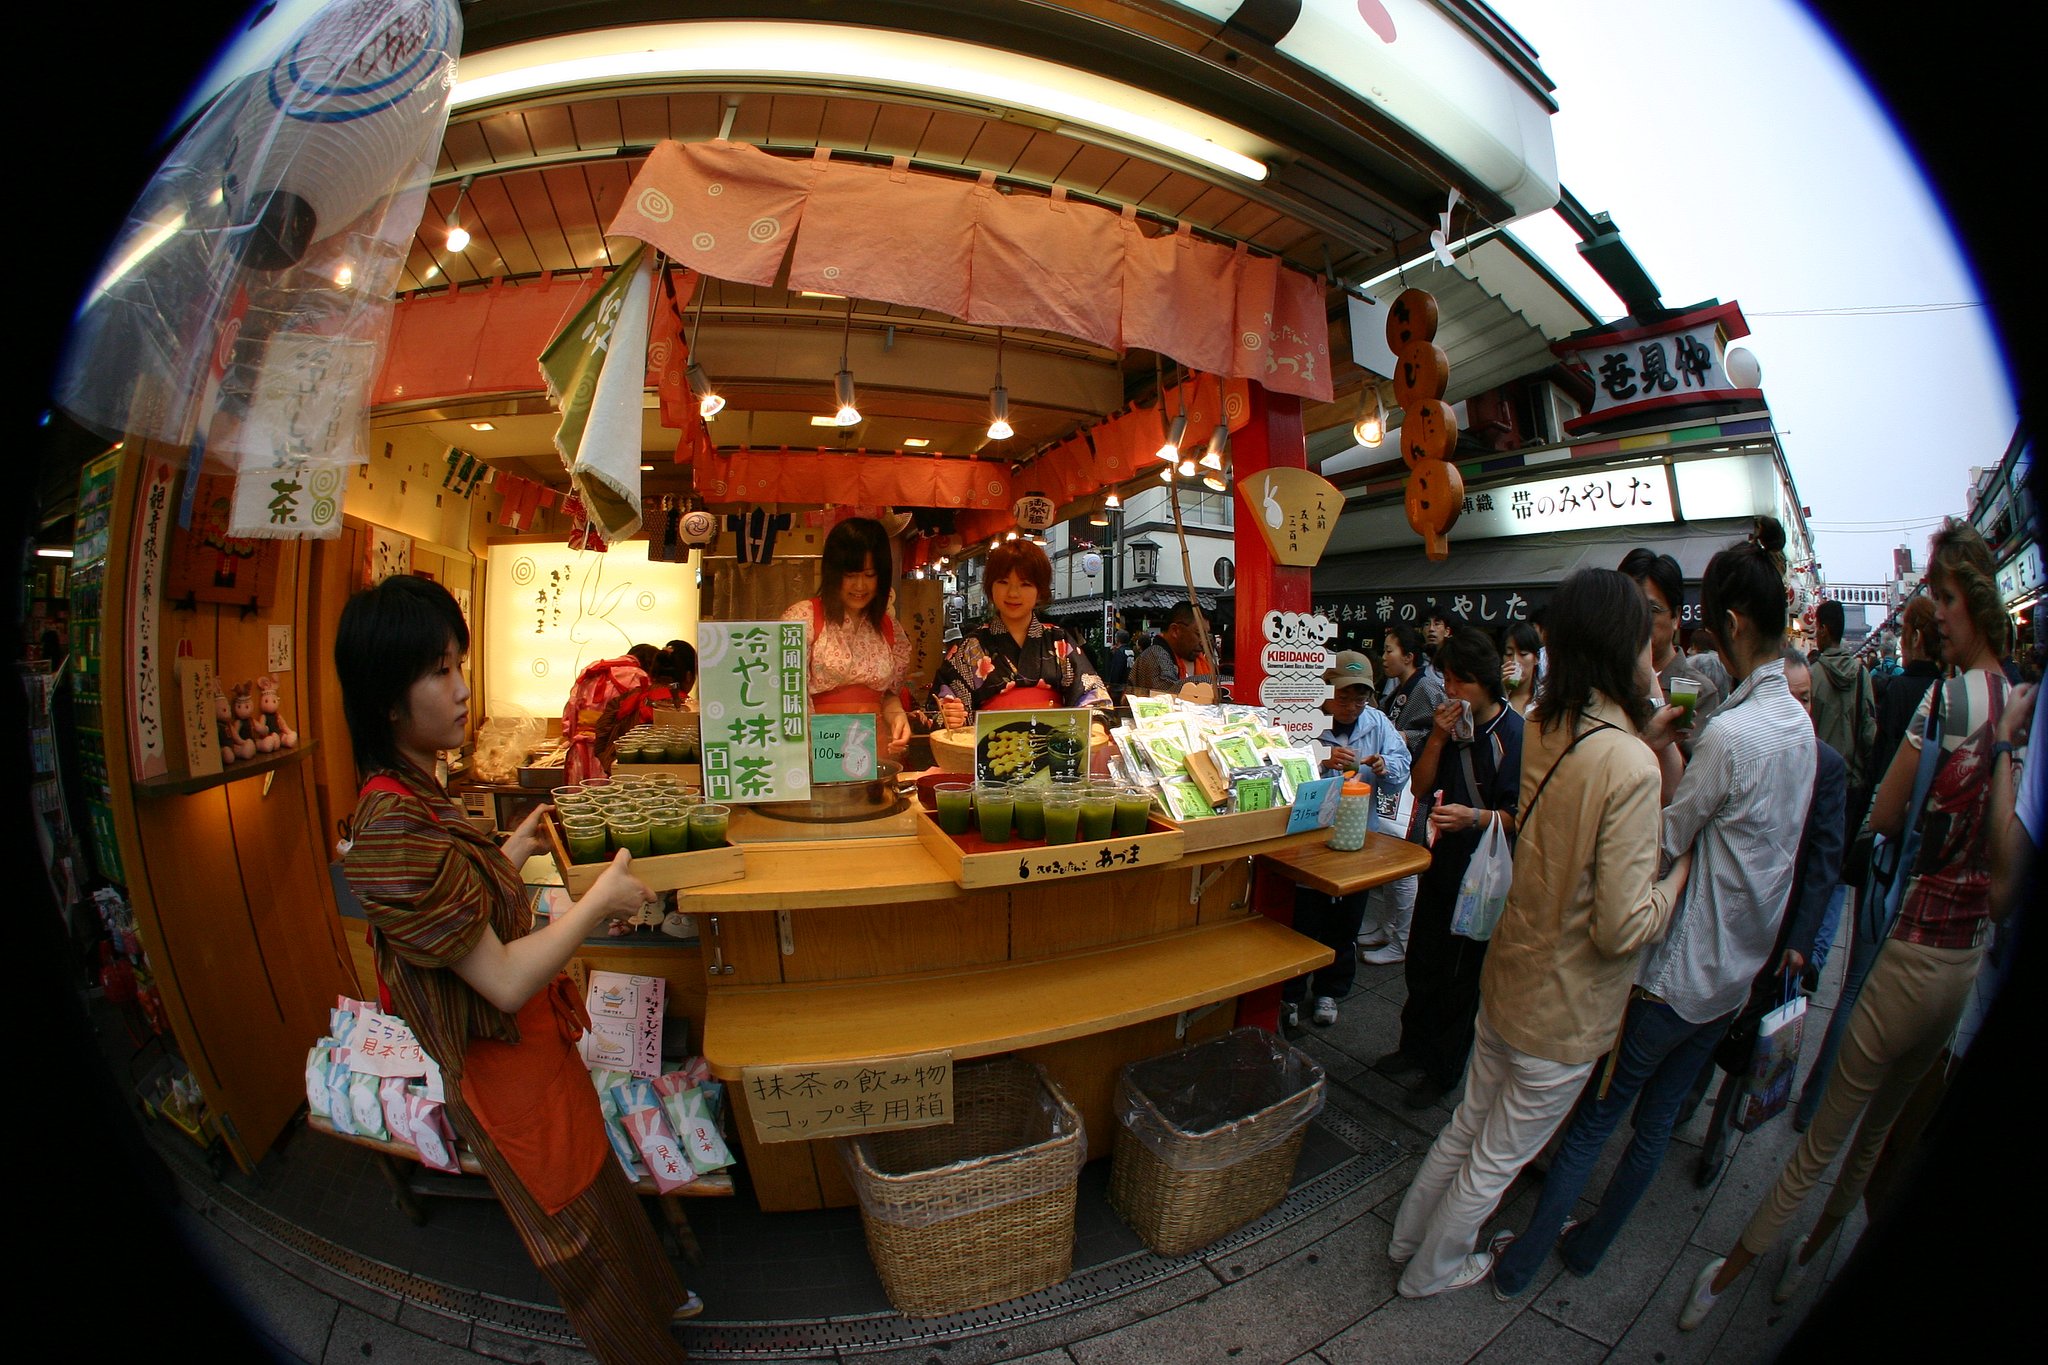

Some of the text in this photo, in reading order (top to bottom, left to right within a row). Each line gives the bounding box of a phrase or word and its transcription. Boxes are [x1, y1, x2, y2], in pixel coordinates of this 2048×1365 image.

[1394, 299, 1438, 511] きびだんご
[1315, 492, 1327, 530] 一人前
[1511, 476, 1653, 520] 帯のみやした
[1299, 509, 1310, 534] 五本
[535, 588, 548, 634] あづま
[1375, 592, 1528, 622] 帯のやした
[1271, 615, 1328, 641] きびだんご
[1267, 650, 1325, 663] KIBIDANGO
[782, 626, 802, 737] 涼風甘味処
[727, 627, 778, 797] 冷やし抹茶
[706, 747, 730, 798] 百円
[1095, 843, 1141, 869] あづま
[752, 1065, 946, 1100] 抹茶の飲み物
[766, 1092, 945, 1129] コップ専用箱
